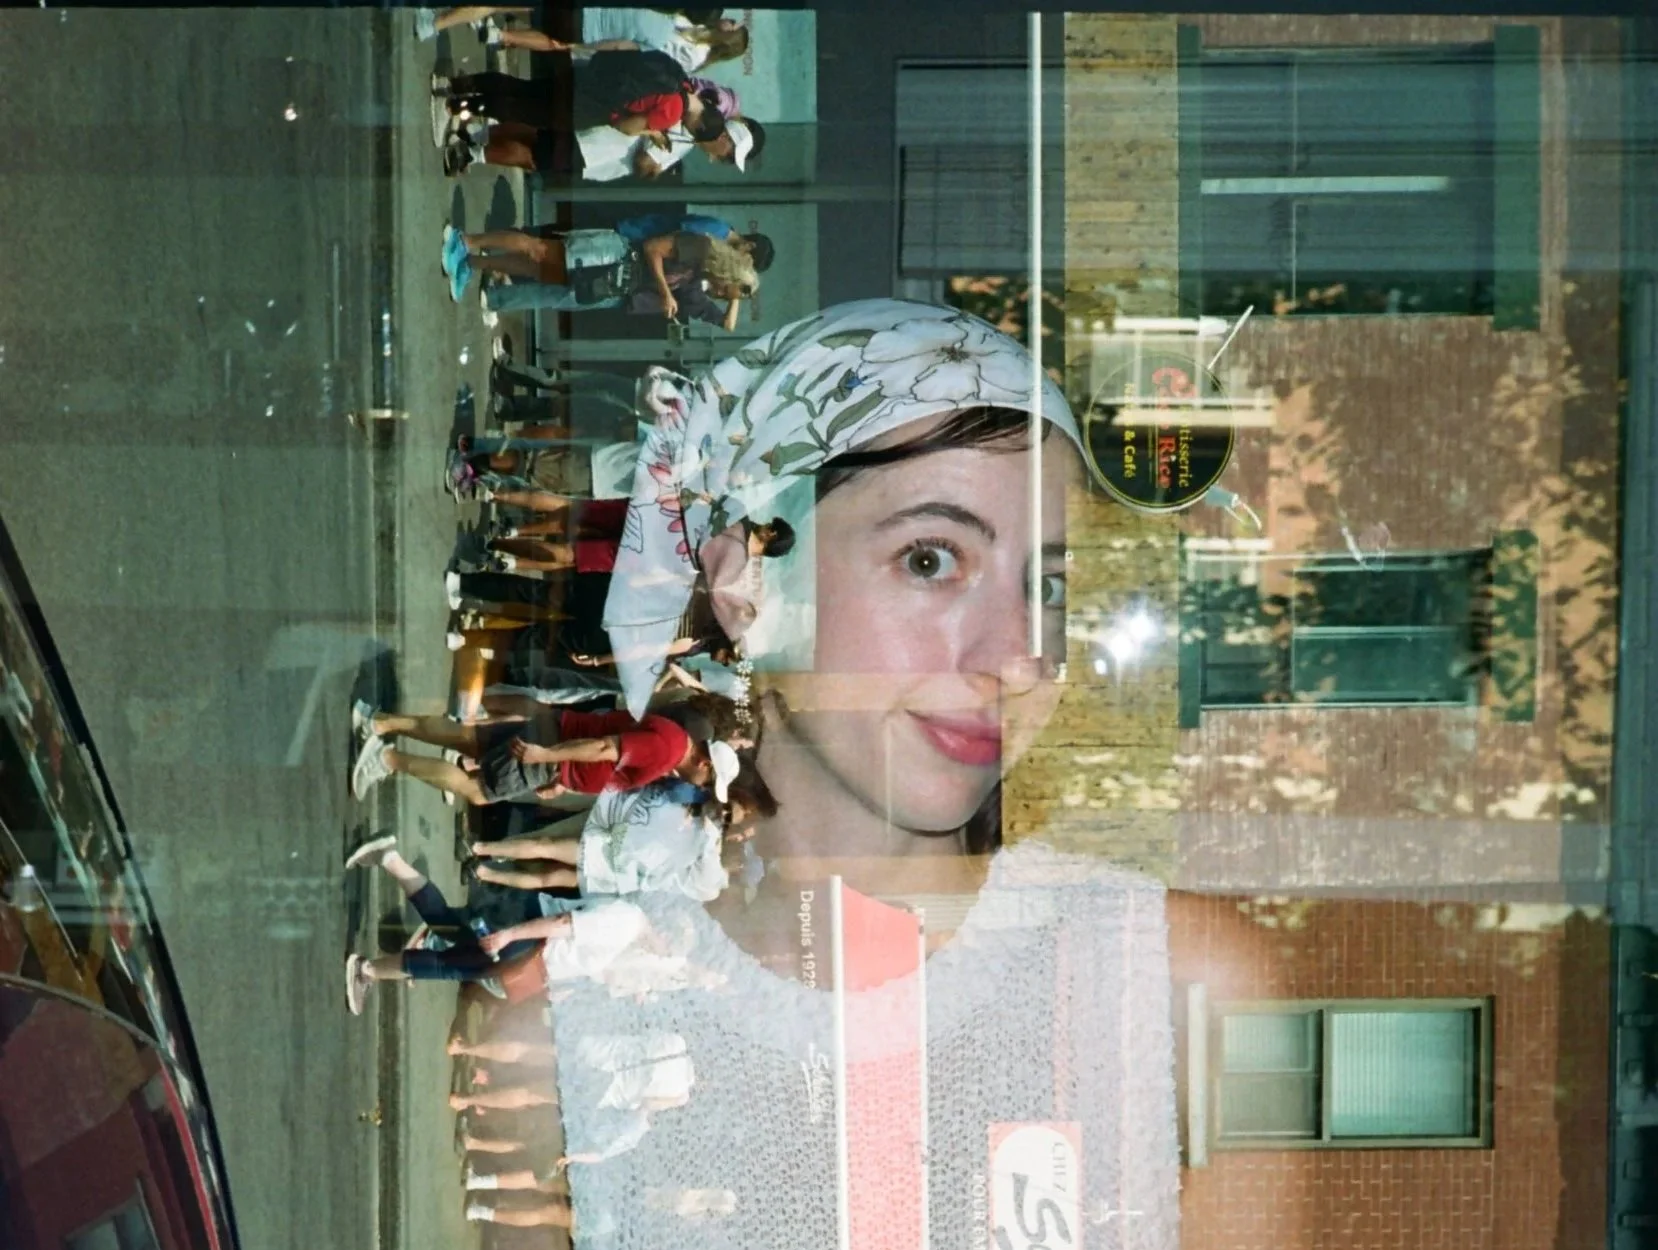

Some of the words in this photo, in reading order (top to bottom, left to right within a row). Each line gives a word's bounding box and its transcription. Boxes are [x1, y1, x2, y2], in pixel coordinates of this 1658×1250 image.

[1123, 430, 1136, 442] &
[1123, 445, 1137, 478] Café
[797, 890, 816, 947] Depuis
[801, 951, 817, 990] 1928
[972, 1173, 987, 1221] POUR
